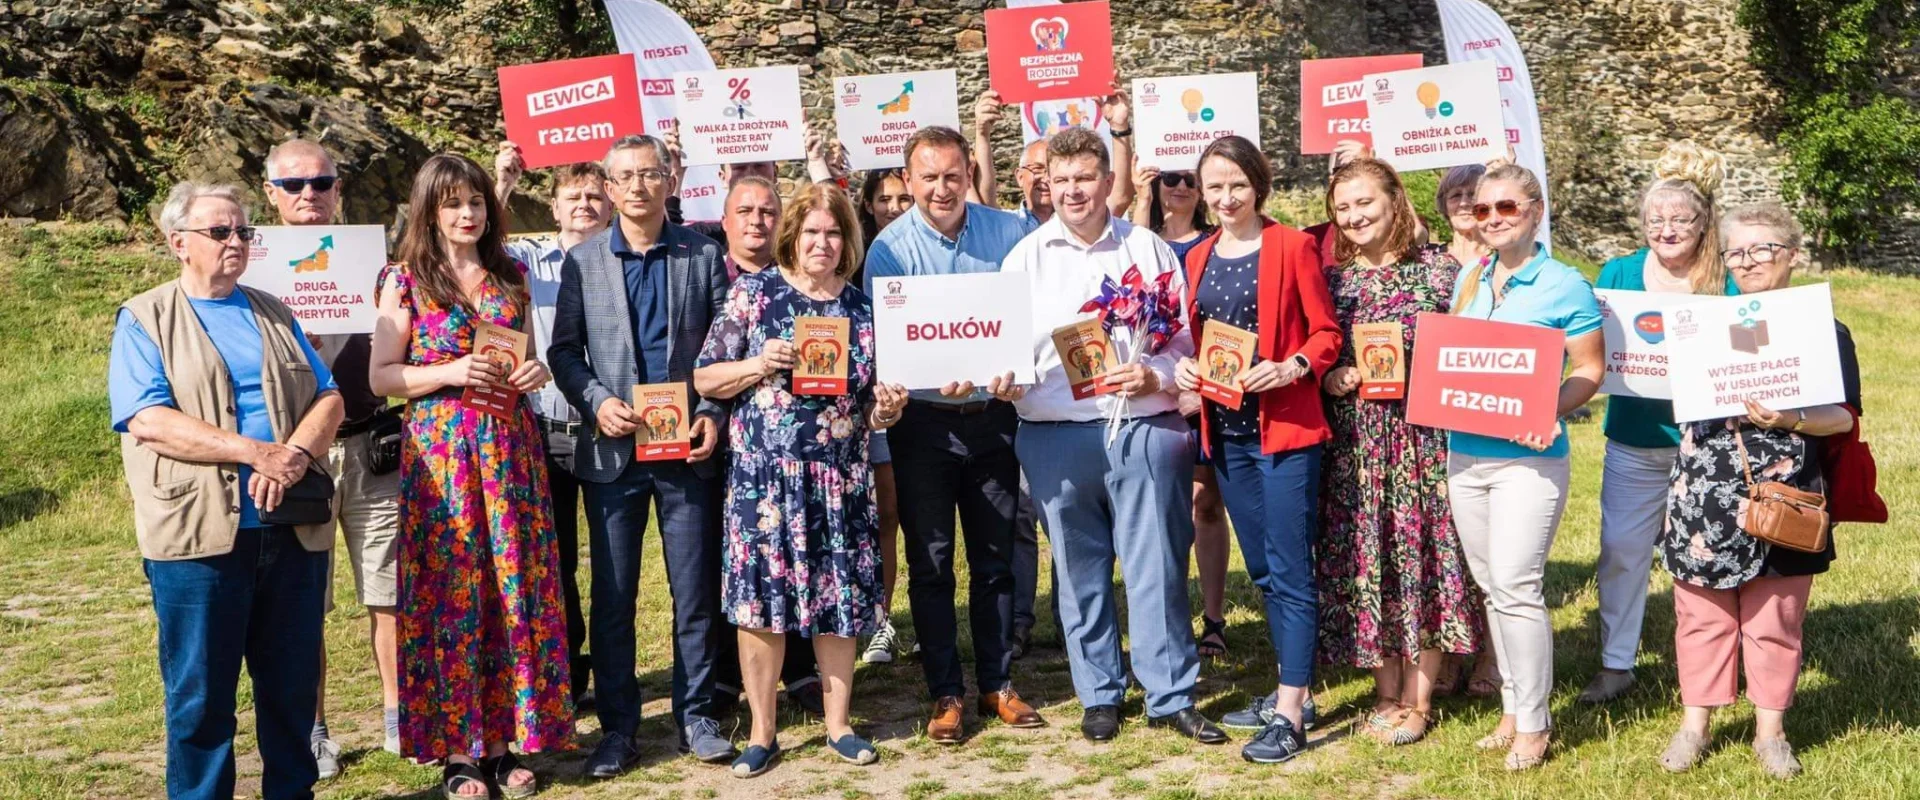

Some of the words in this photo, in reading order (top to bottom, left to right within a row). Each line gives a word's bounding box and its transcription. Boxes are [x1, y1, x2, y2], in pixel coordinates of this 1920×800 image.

[1020, 52, 1083, 66] BEZPIECZNA
[1029, 66, 1077, 79] RODZINA
[533, 81, 611, 112] LEWICA
[1327, 83, 1365, 102] LEW
[694, 124, 728, 134] WALKA
[730, 123, 736, 131] Z
[738, 119, 789, 131] DROŻYZNĄ
[881, 120, 917, 131] DRUGA
[1327, 118, 1371, 135] raze
[1402, 127, 1451, 141] OBNIŻKA
[1453, 124, 1477, 135] CEN
[538, 121, 614, 146] razem
[716, 133, 747, 144] NIŻSZE
[749, 133, 773, 142] RATY
[1164, 130, 1211, 143] OBNIŻKA
[716, 143, 769, 155] KREDYTÓW
[1155, 146, 1196, 157] ENERGII
[1394, 143, 1437, 156] ENERGII
[1446, 137, 1489, 151] PALIWA
[294, 281, 338, 292] DRUGA
[280, 294, 364, 306] ALORYZACJA
[293, 308, 350, 319] MERYTUR
[906, 317, 1002, 341] BOLKÓW
[1444, 351, 1529, 369] LEWICA
[1612, 351, 1647, 362] CIEPŁY
[1616, 364, 1667, 377] KAŻDEGO
[1708, 362, 1758, 379] WYŻSZE
[1760, 356, 1800, 371] PŁACE
[1714, 382, 1727, 392] W
[1730, 372, 1799, 390] USŁUGACH
[1440, 387, 1523, 417] razem
[1715, 386, 1800, 406] PUBLICZNYCH
